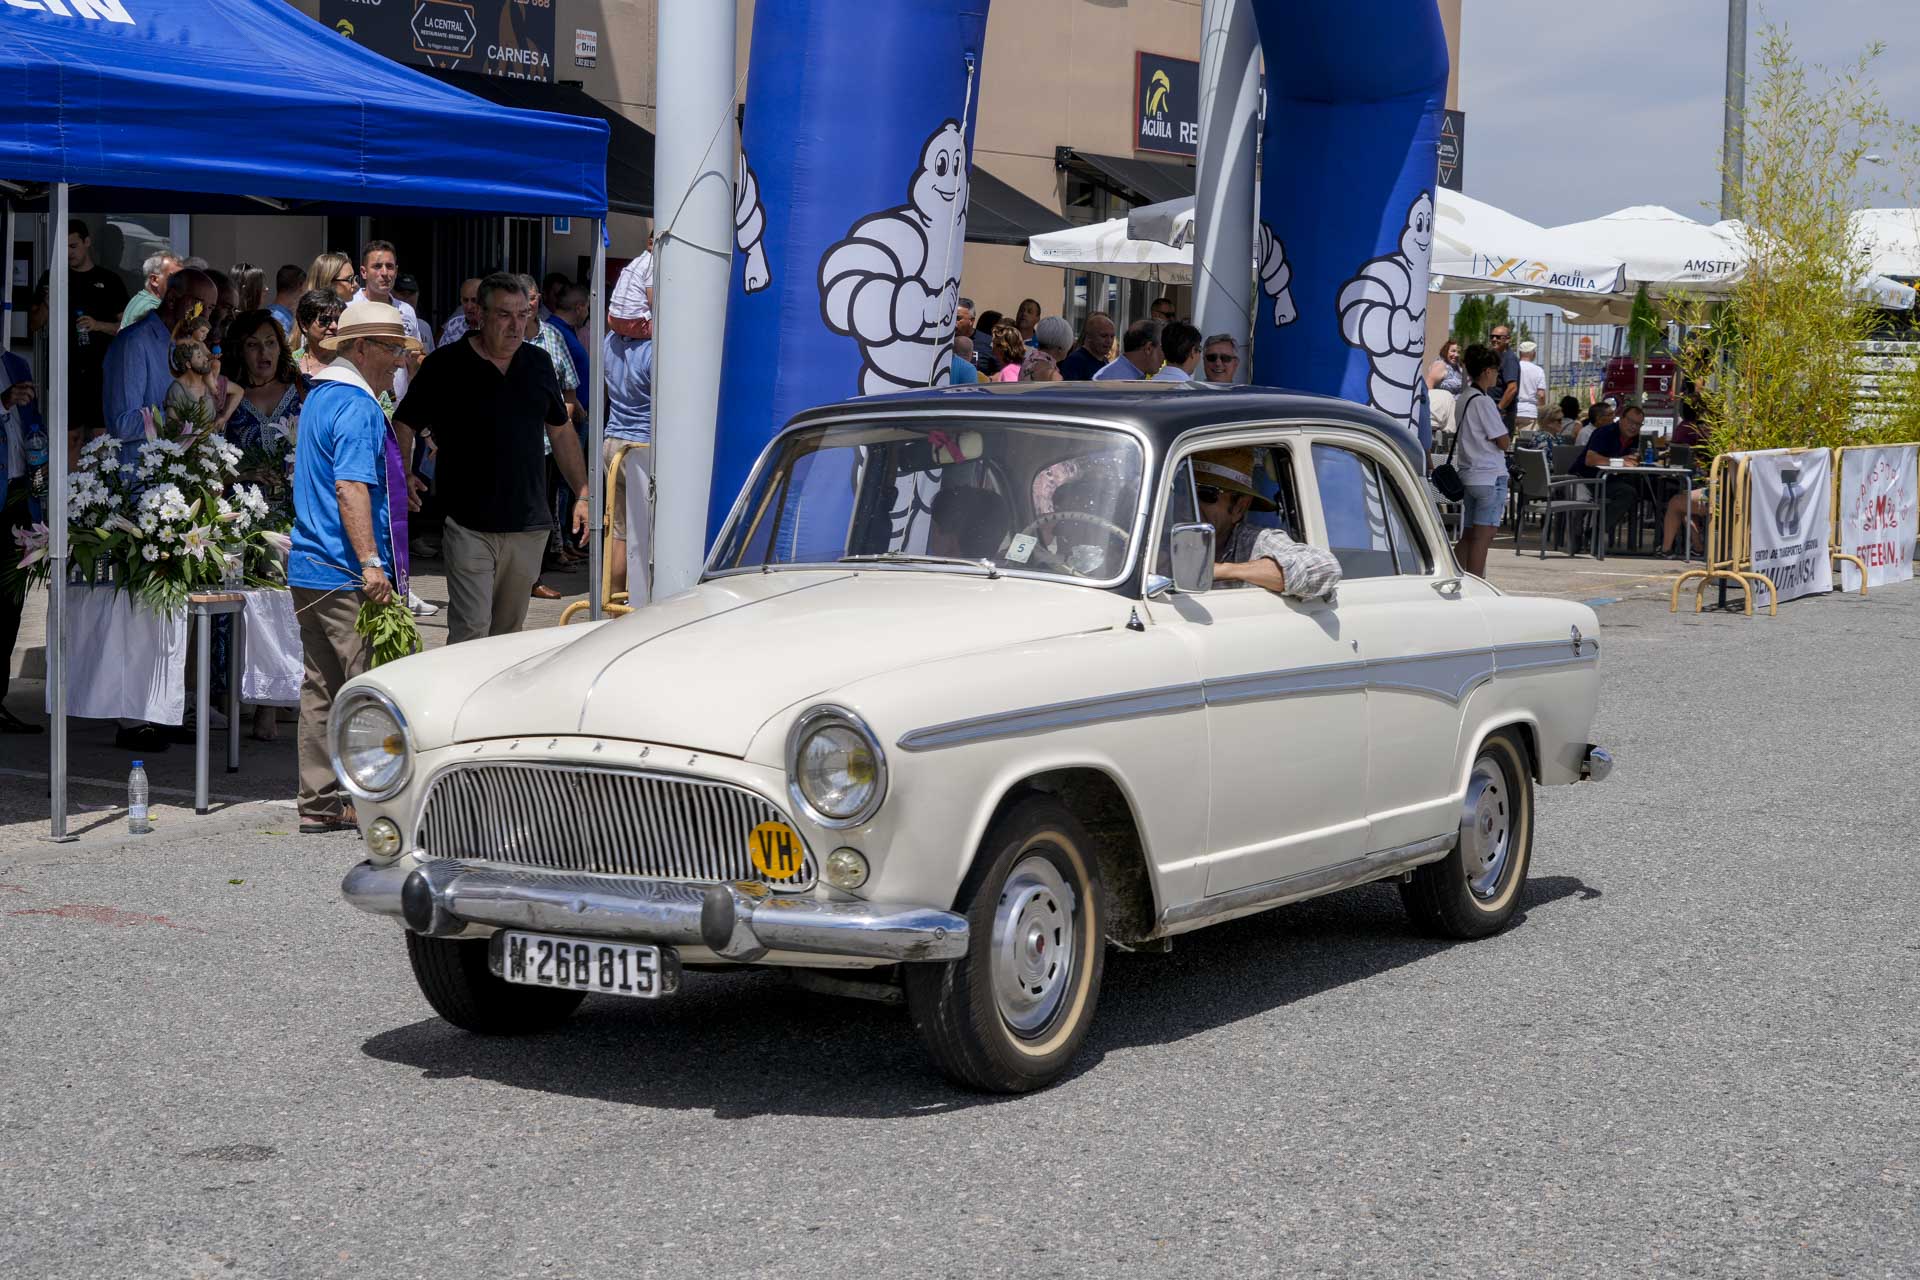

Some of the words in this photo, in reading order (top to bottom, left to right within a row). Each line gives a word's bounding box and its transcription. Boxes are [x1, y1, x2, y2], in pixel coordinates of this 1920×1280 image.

[425, 17, 433, 27] LA
[434, 18, 464, 32] CENTRAL
[488, 45, 539, 65] CARNES
[541, 53, 550, 67] A
[1156, 111, 1163, 120] EL
[1142, 116, 1172, 138] ÁGUILA
[1017, 543, 1026, 553] 5
[1770, 548, 1778, 559] DE
[758, 830, 794, 872] VH
